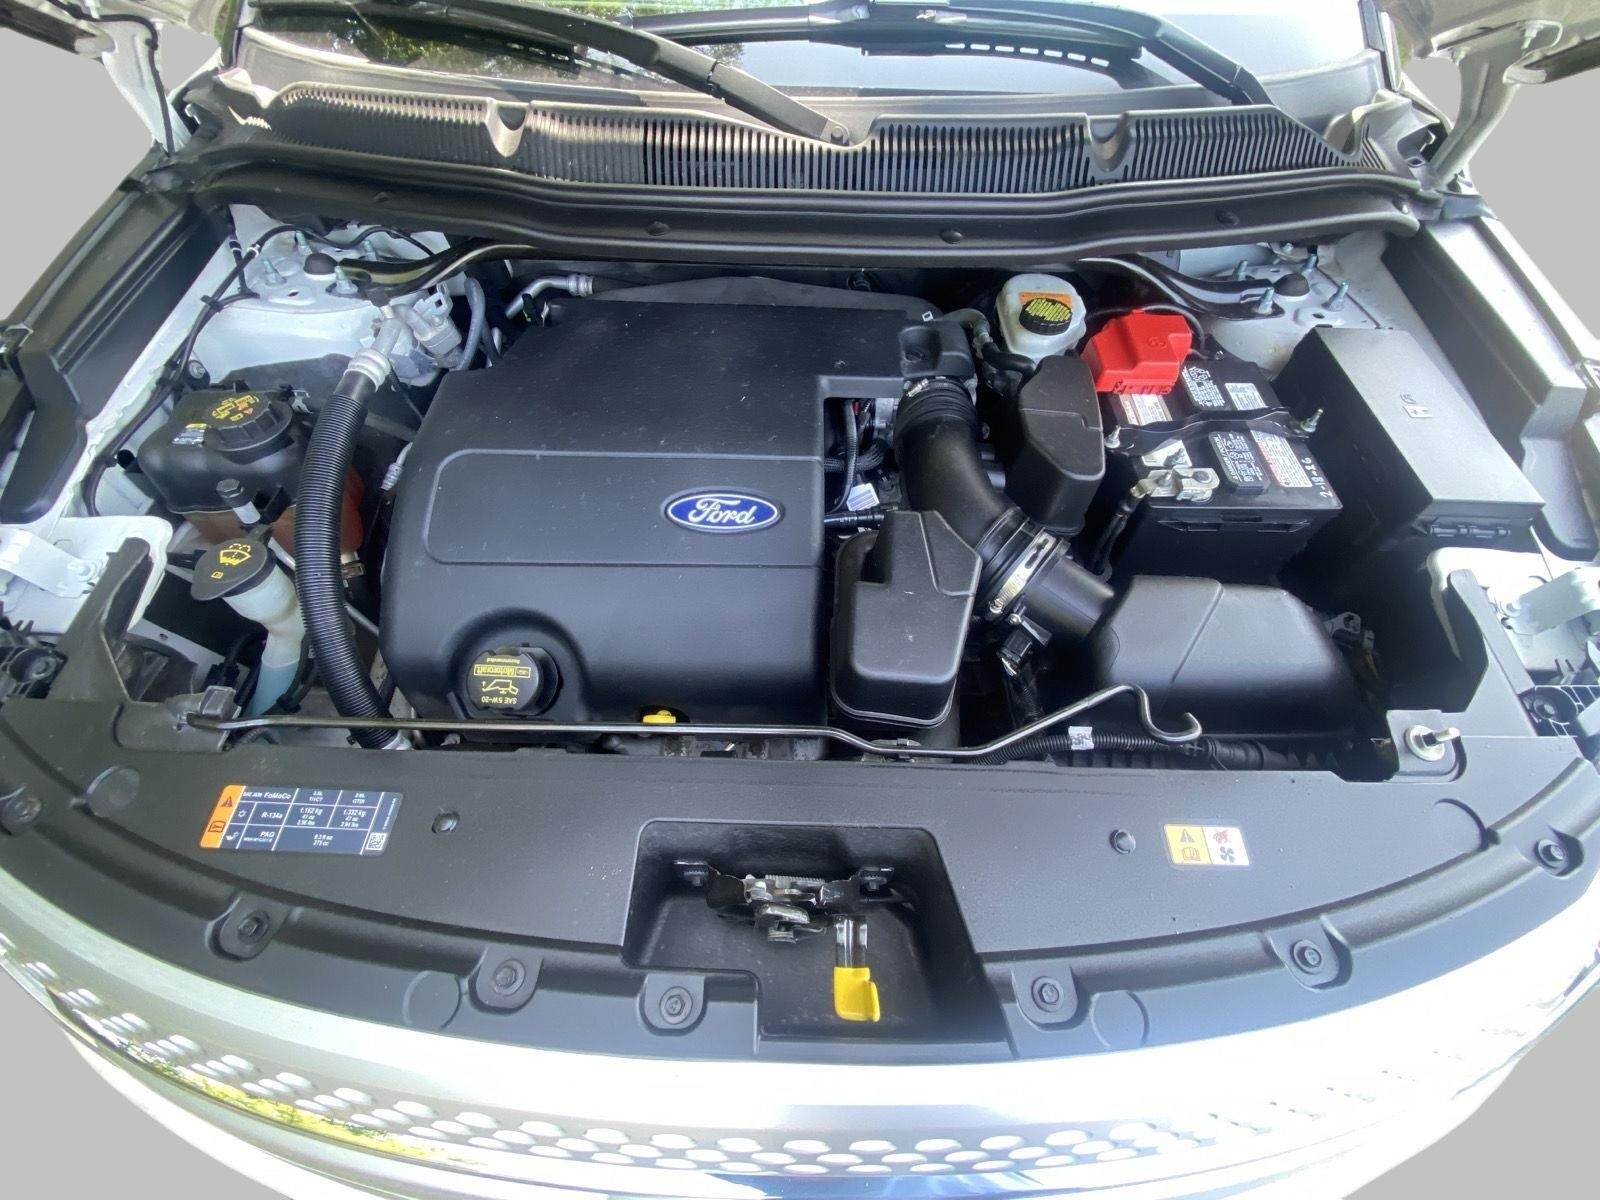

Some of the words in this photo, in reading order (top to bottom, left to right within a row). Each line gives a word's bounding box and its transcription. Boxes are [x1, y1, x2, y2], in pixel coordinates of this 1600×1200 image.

[688, 498, 758, 524] Ford
[476, 665, 515, 676] Motorcraft
[481, 696, 503, 704] 5W-20
[504, 697, 518, 705] SAE
[264, 791, 292, 800] FoMoCo
[261, 811, 284, 819] R-134a
[314, 808, 324, 816] kg
[357, 810, 367, 818] kg
